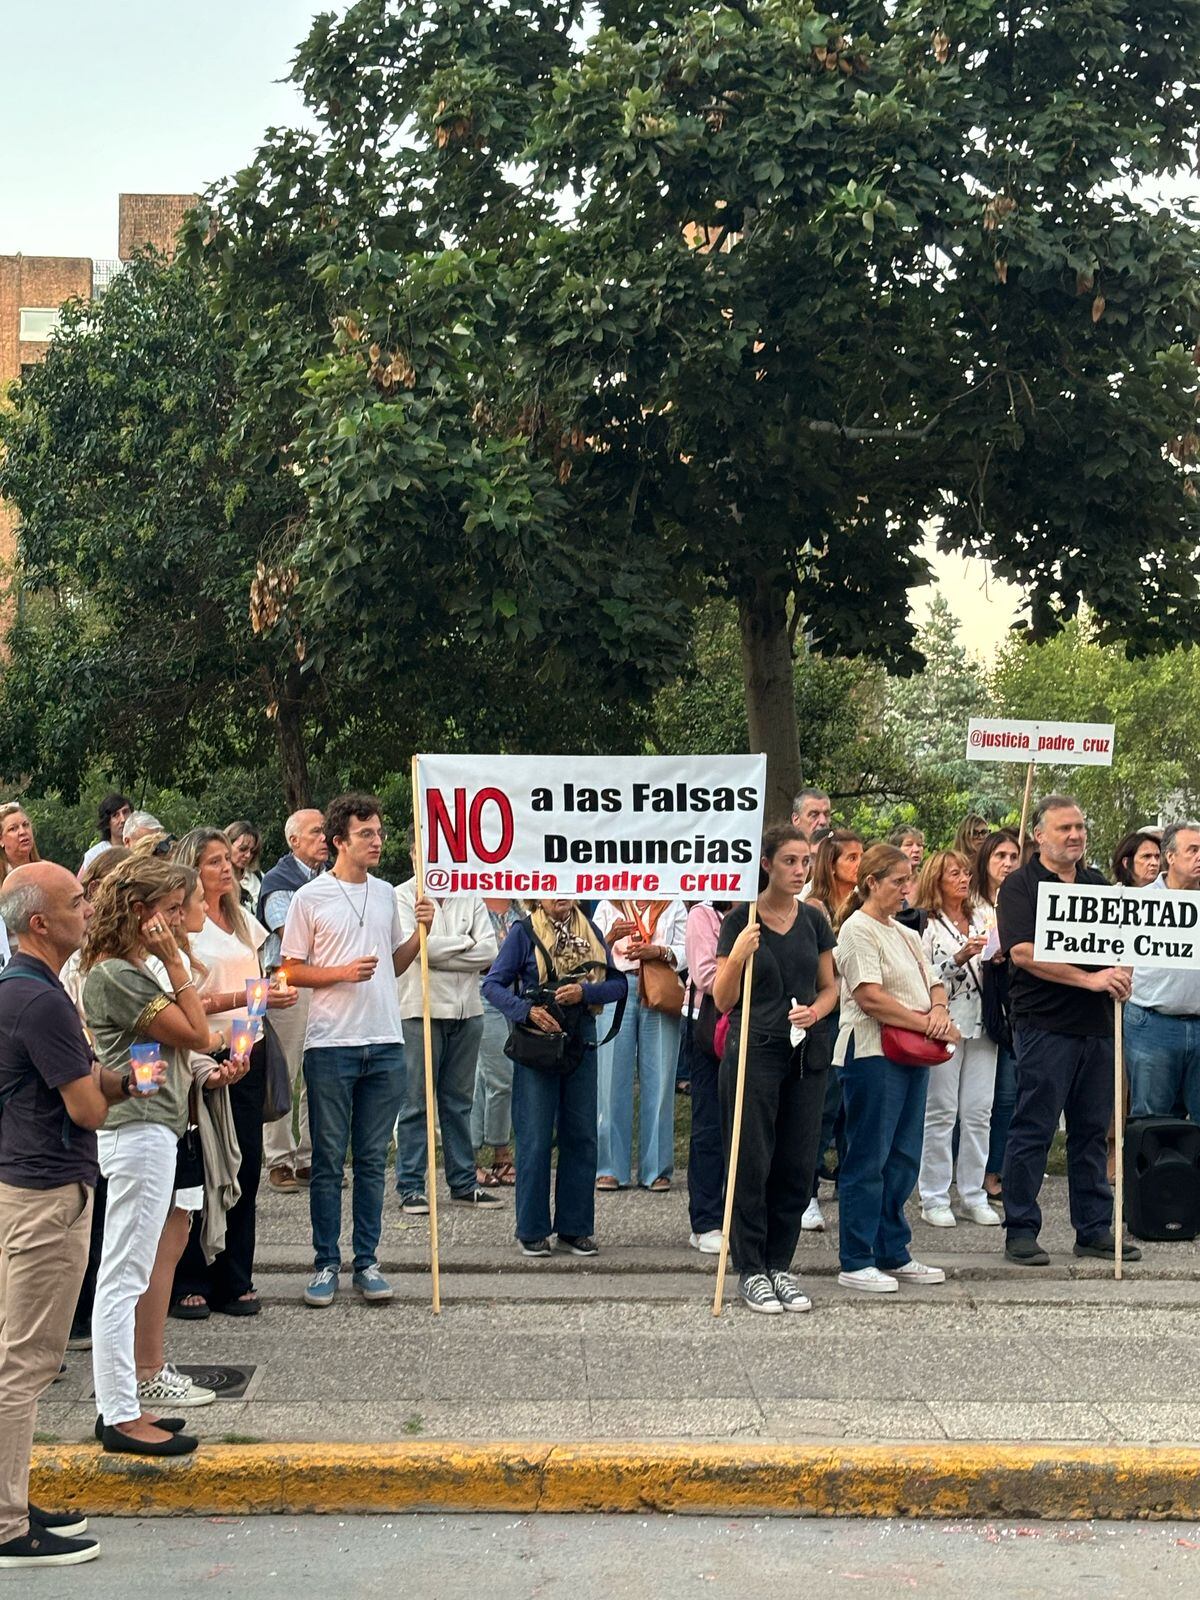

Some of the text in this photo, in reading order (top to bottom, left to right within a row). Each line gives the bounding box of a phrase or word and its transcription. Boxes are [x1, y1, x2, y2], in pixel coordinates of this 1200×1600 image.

[531, 783, 758, 812] a las Falsas
[426, 787, 515, 864] NO
[544, 834, 752, 864] Denuncias
[1047, 894, 1198, 928] LIBERTAD
[1044, 930, 1194, 958] Padre Cruz
